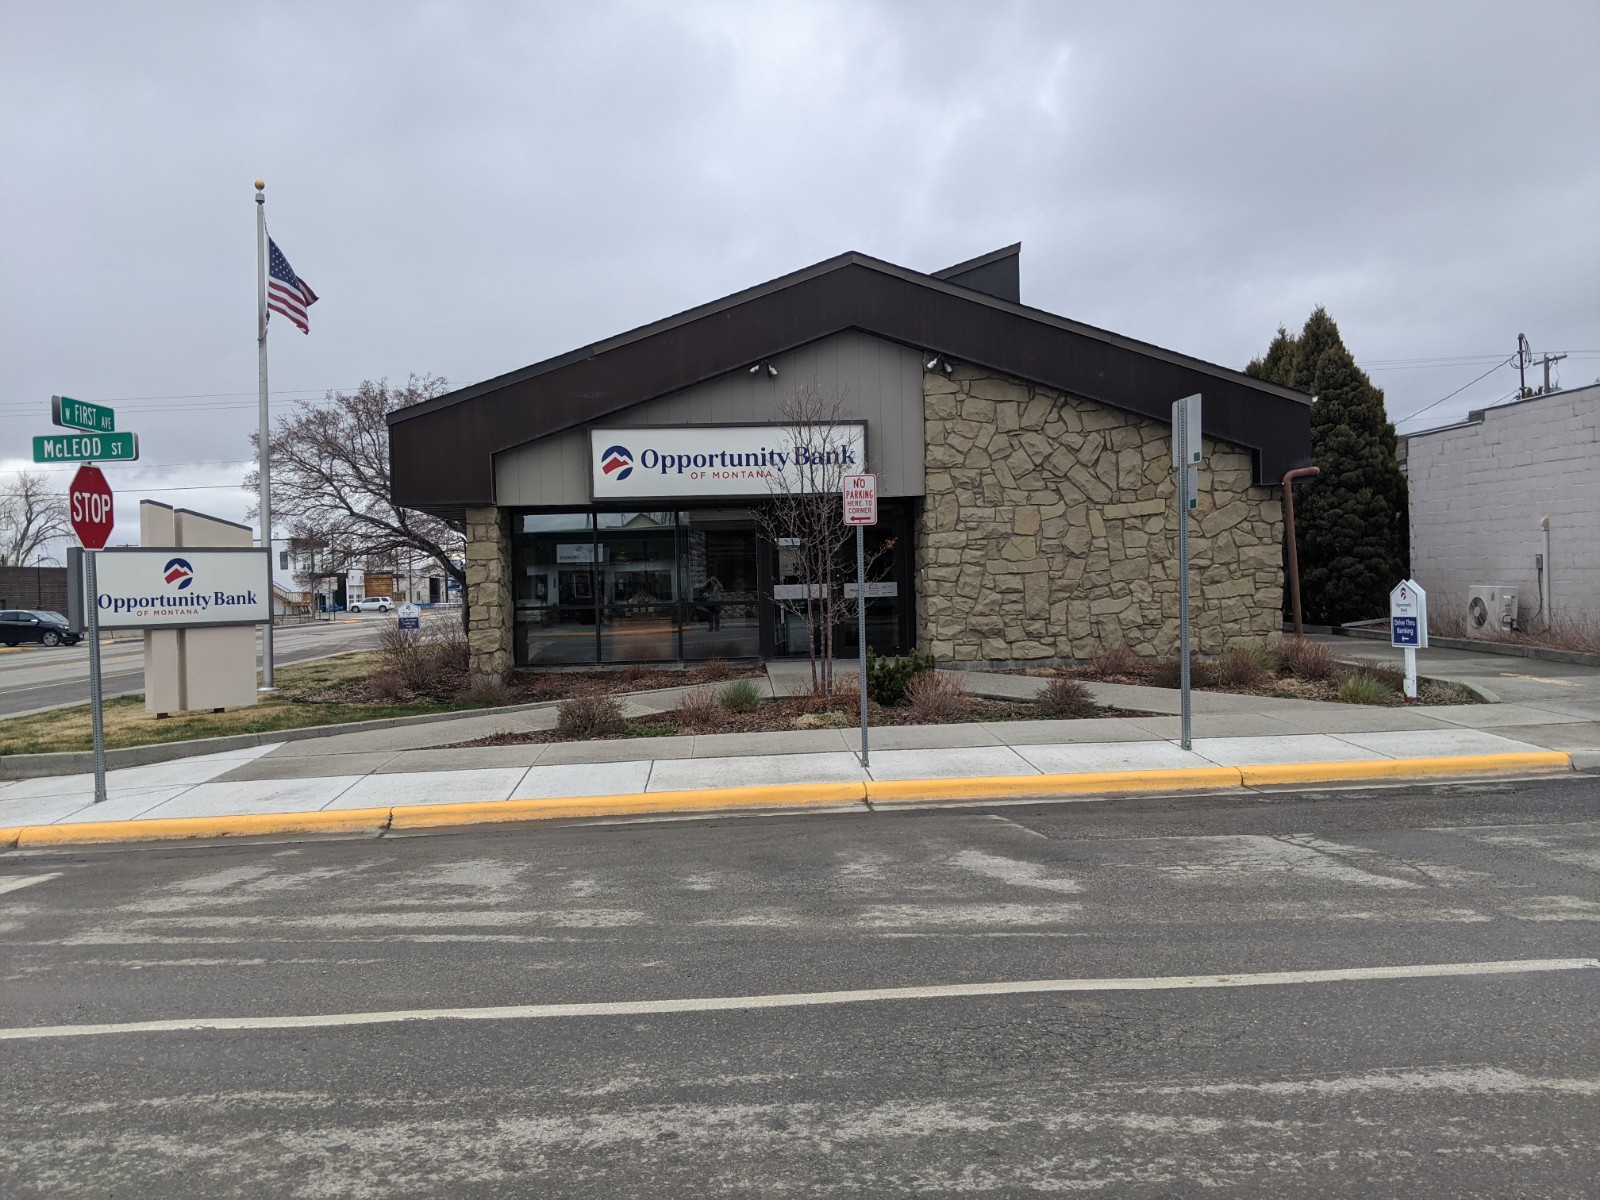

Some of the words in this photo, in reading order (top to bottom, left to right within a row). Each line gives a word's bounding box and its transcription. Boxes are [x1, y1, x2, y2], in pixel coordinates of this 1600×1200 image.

[64, 407, 71, 421] W
[74, 403, 97, 427] FIRST
[101, 415, 112, 430] AVE
[43, 437, 101, 458] McLEOD
[111, 442, 122, 455] ST
[640, 446, 790, 475] Opportunity
[794, 444, 856, 466] Bank
[690, 471, 707, 480] OF
[712, 469, 774, 480] MONTANA
[853, 478, 866, 489] NO
[846, 490, 874, 500] PARKING
[72, 491, 111, 524] STOP
[98, 592, 212, 613] Opportunity
[213, 590, 258, 606] Bank
[1396, 627, 1414, 636] Banking
